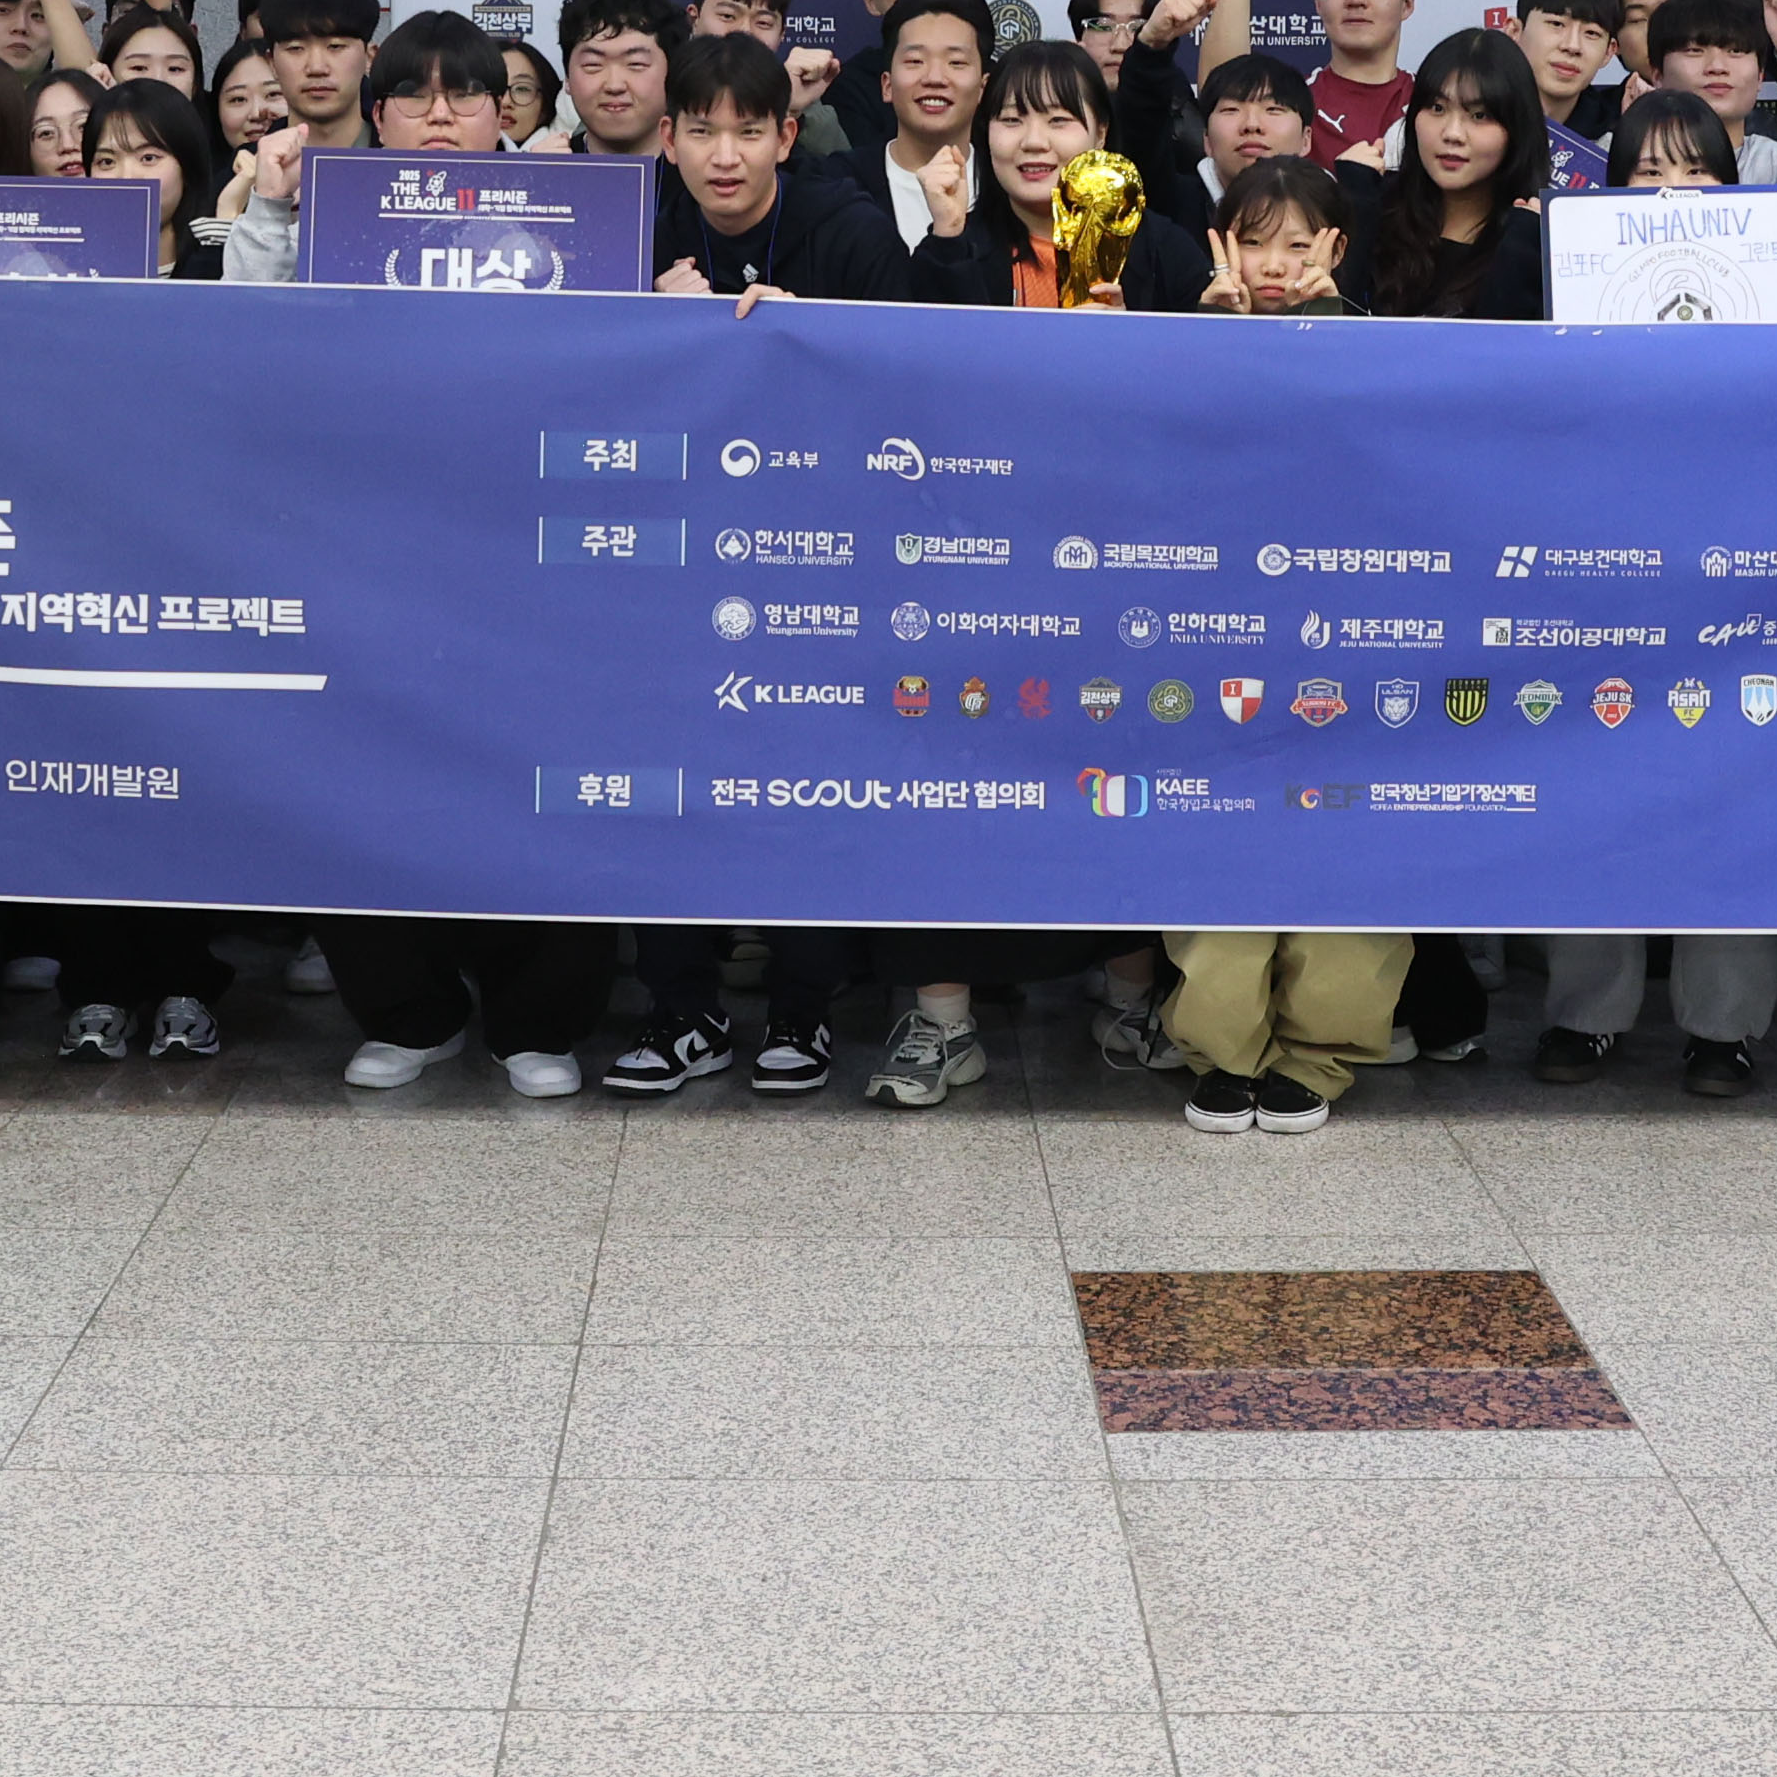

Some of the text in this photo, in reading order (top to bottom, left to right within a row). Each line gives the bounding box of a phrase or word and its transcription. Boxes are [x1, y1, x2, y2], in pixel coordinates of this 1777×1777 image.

[474, 12, 531, 31] 김천상무
[1250, 14, 1326, 34] 산대학교
[1267, 36, 1327, 45] UNIVERSITY
[399, 170, 420, 181] 2025
[390, 183, 420, 195] THE
[479, 189, 527, 204] 프리시즌
[381, 196, 392, 209] K
[395, 195, 456, 211] LEAGUE
[456, 189, 473, 210] 11
[421, 248, 531, 291] 대상
[583, 439, 637, 472] 주최
[769, 451, 819, 469] 교육부
[867, 452, 912, 472] NRF
[930, 457, 1013, 476] 한국연구재단
[582, 526, 636, 557] 주관
[754, 529, 854, 557] 한서대학교
[924, 536, 1010, 556] 경남대학교
[756, 556, 854, 566] HANSEO UNIVERSITY
[923, 556, 1010, 565] KYUNGNAM UNIVERSITY
[1104, 543, 1218, 563] 국립목포대학교
[1293, 548, 1452, 573] 국립창원대학교
[1545, 548, 1663, 568] 대구보건대학교
[1134, 562, 1172, 570] NATIONAL
[1735, 568, 1765, 576] MASAN
[2, 591, 148, 634] 지역혁신
[158, 596, 306, 636] 프로젝트
[764, 604, 860, 626] 영남대학교
[1168, 613, 1266, 633] 인하대학교
[766, 626, 858, 637] Yeungnam University
[937, 612, 1081, 637] 이화여자대학교
[1340, 618, 1444, 640] 제주대학교
[1170, 634, 1265, 645] INHA UNIVERSITY
[1339, 640, 1443, 649] JEJU NATIONAL UNIVERSITY
[1515, 626, 1666, 647] 조선이공대학교
[755, 685, 864, 703] K LEAGUE
[1081, 690, 1121, 705] 김천상무
[1593, 692, 1632, 704] JEJU SK
[5, 760, 180, 800] 인재개발원
[1156, 778, 1209, 796] KAEE
[578, 774, 631, 807] 후원
[712, 778, 760, 806] 전국
[896, 780, 968, 808] 사업단
[974, 780, 1044, 809] 협의회
[1370, 784, 1536, 803] 한국청년기업가정신재단
[1157, 798, 1256, 812] 한국창업교육협의회
